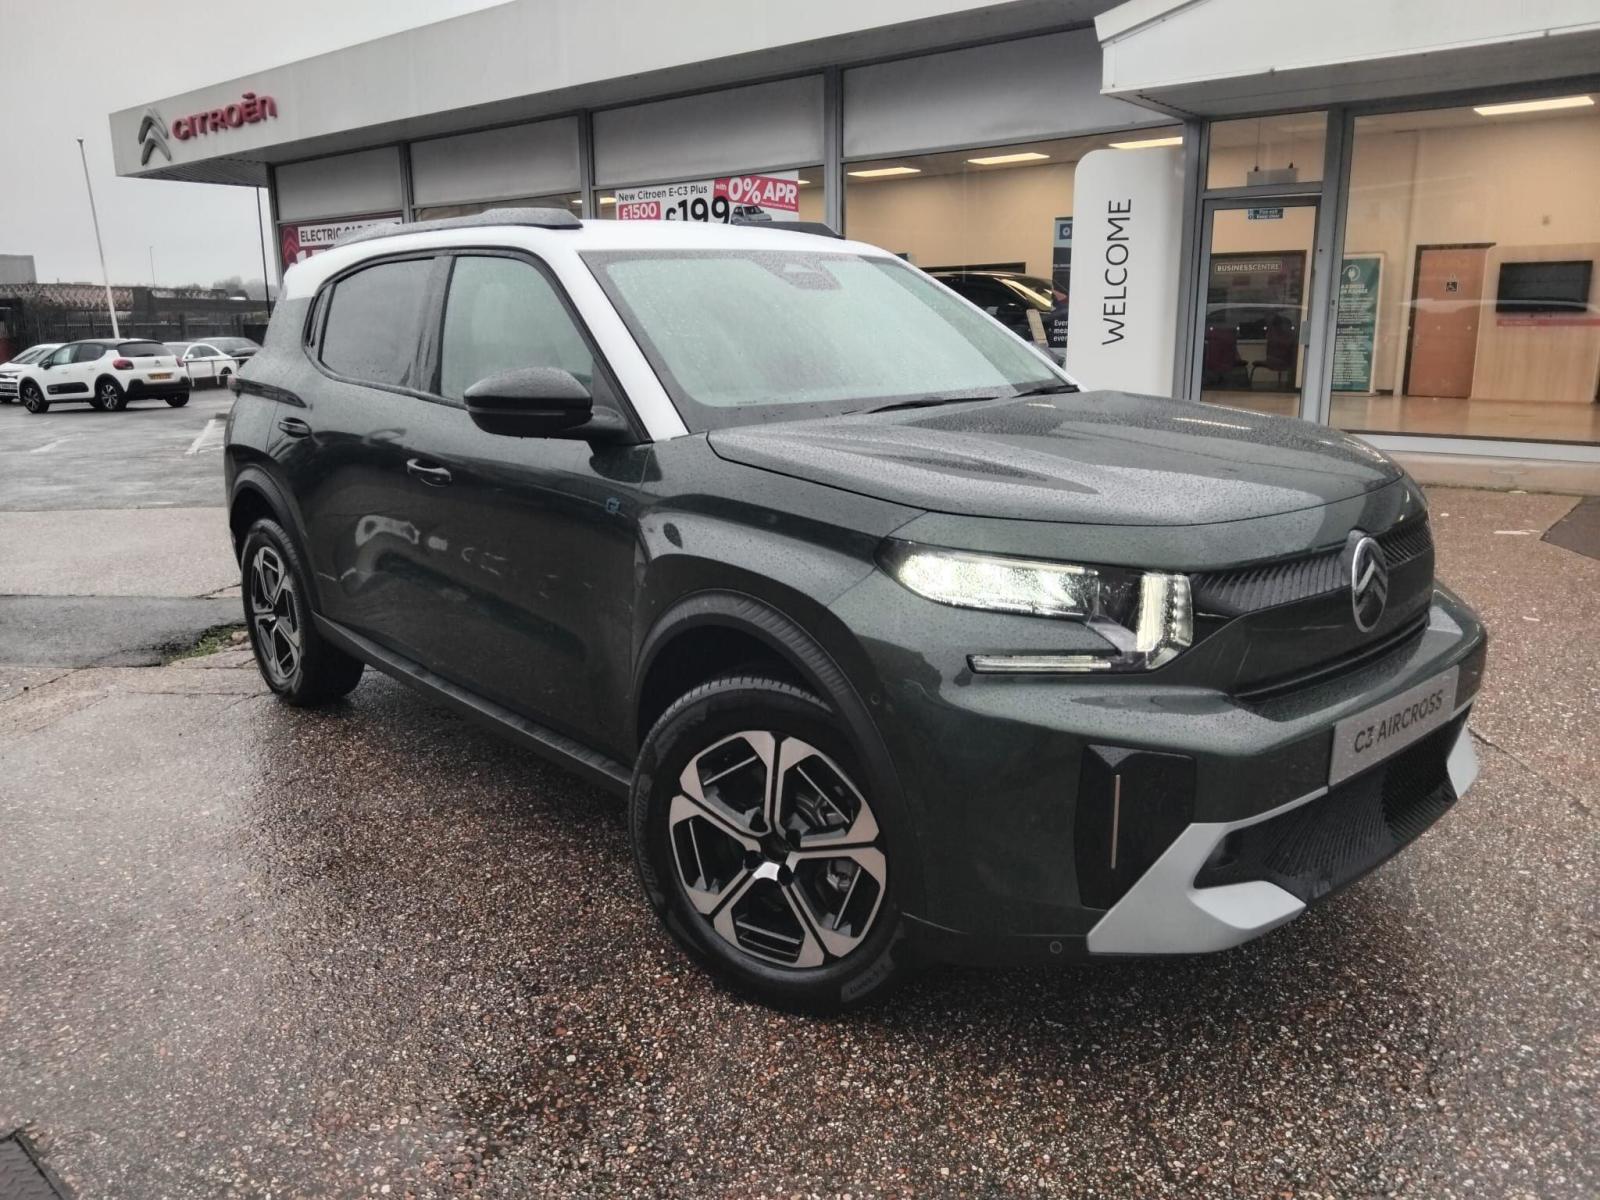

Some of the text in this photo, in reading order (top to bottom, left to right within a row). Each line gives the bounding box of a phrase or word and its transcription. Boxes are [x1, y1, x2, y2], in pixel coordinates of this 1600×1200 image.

[618, 184, 708, 202] New Citroen E-C3 Plus
[715, 176, 797, 205] with 0% APR
[622, 203, 657, 219] £1500
[1102, 198, 1132, 345] WELCOME
[1354, 689, 1443, 753] C3 AIRCROSS
